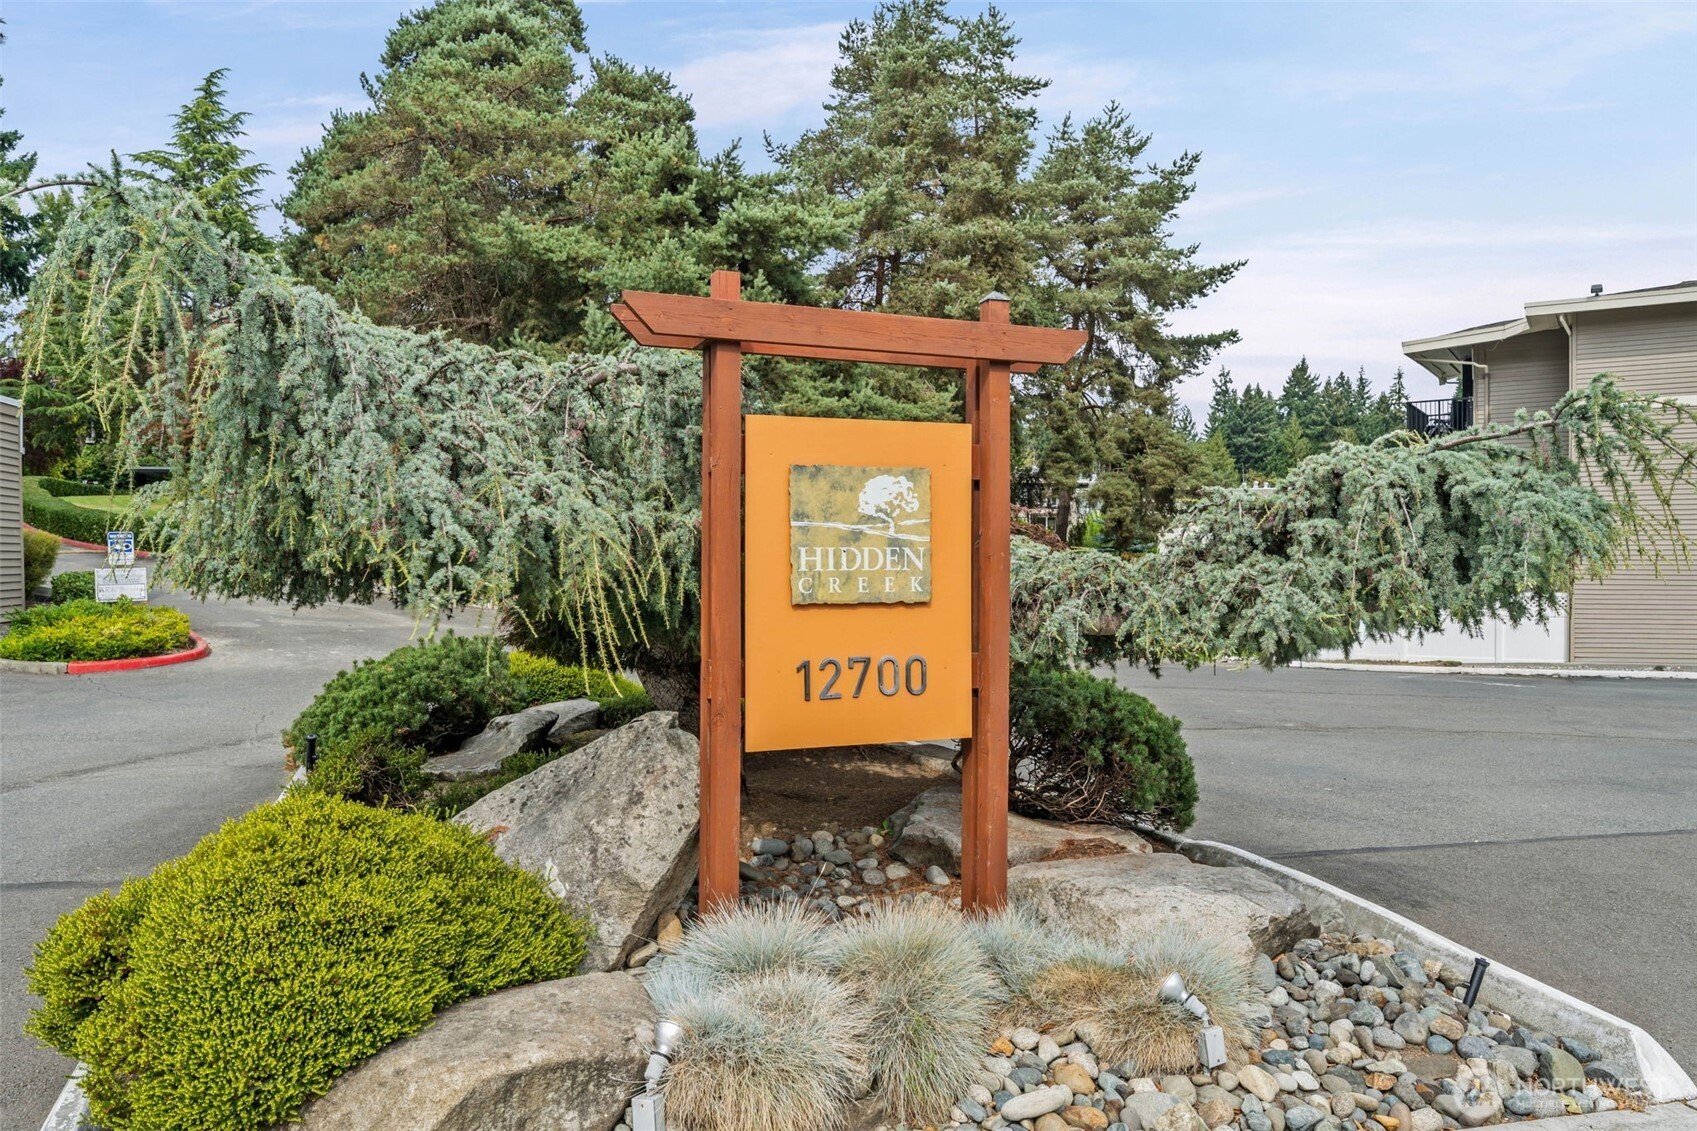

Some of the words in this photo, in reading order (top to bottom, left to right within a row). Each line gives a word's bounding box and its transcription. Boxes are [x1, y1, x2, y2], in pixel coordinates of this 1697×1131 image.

[798, 546, 926, 571] HIDDEN
[798, 576, 923, 594] CREEK
[796, 655, 927, 702] 12700
